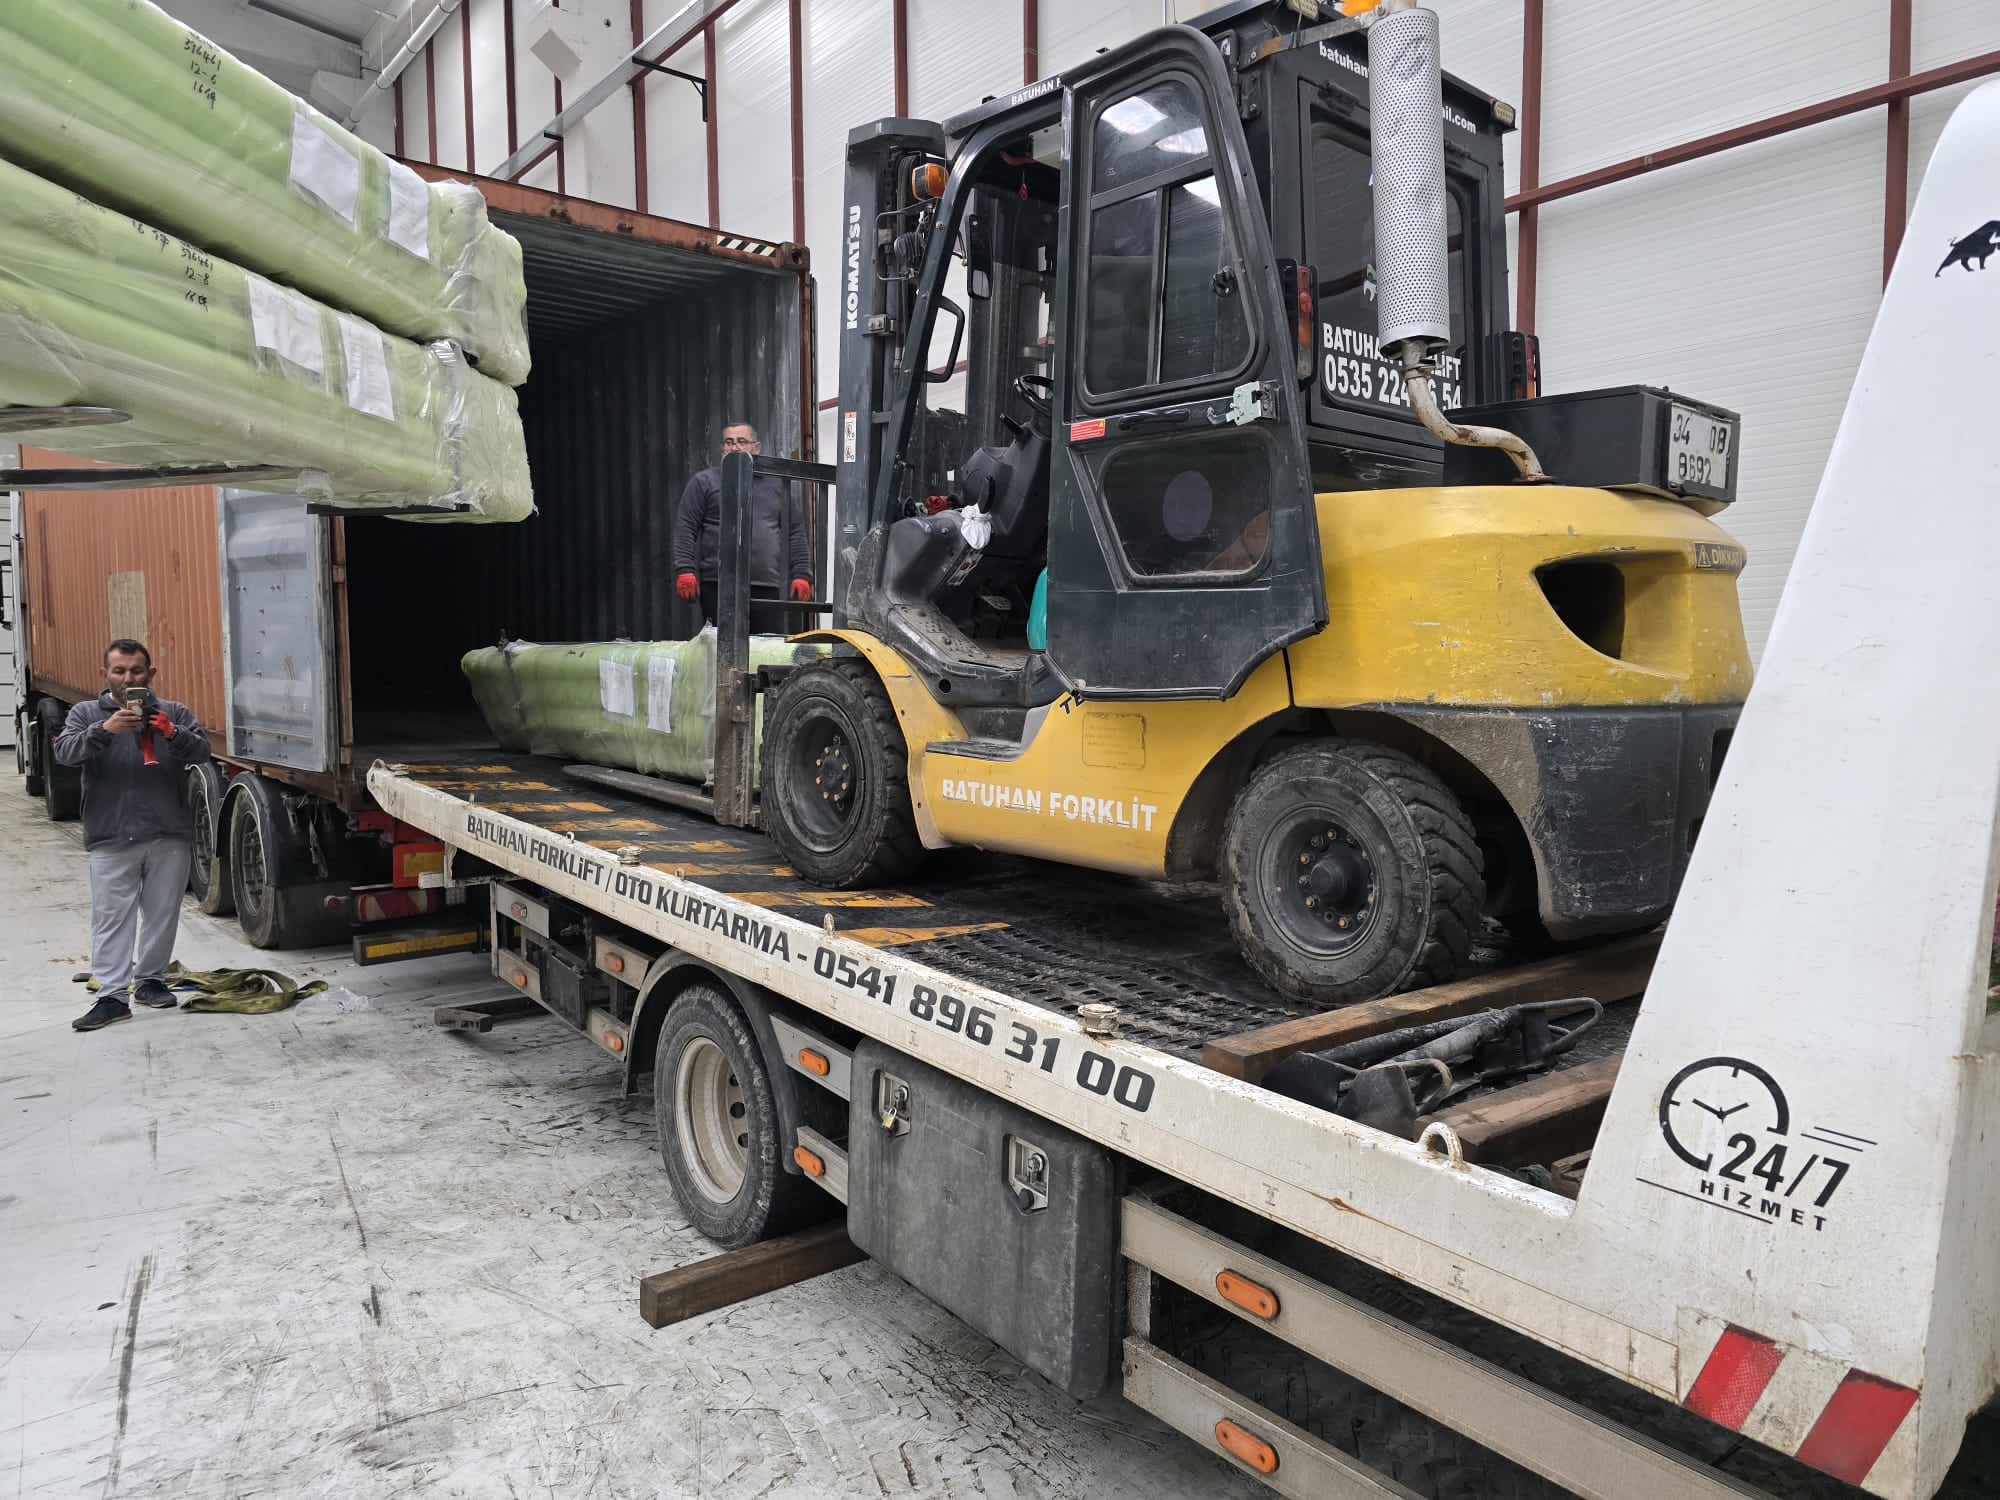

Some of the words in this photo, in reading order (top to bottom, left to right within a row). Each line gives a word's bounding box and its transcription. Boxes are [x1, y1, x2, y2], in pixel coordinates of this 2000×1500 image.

[1011, 79, 1054, 105] BATUHAN
[846, 205, 861, 330] KOMATSU
[1323, 323, 1393, 363] BATUHA
[1325, 354, 1373, 400] 0535
[1378, 366, 1410, 408] 224
[1442, 382, 1462, 410] 54
[1673, 413, 1691, 445] 34
[942, 778, 1041, 814] BATUHAN
[1049, 791, 1158, 832] FORKLİT
[467, 814, 527, 855] BATUHAN
[605, 867, 613, 893] /
[615, 871, 652, 906] OTO
[656, 886, 792, 962] KURTARMA
[813, 946, 898, 1006] 0541
[909, 984, 997, 1047] 896
[1004, 1021, 1061, 1074] 31
[1076, 1050, 1156, 1113] 00
[1718, 1132, 1851, 1208] 24/7
[1699, 1178, 1828, 1232] HİZMET
